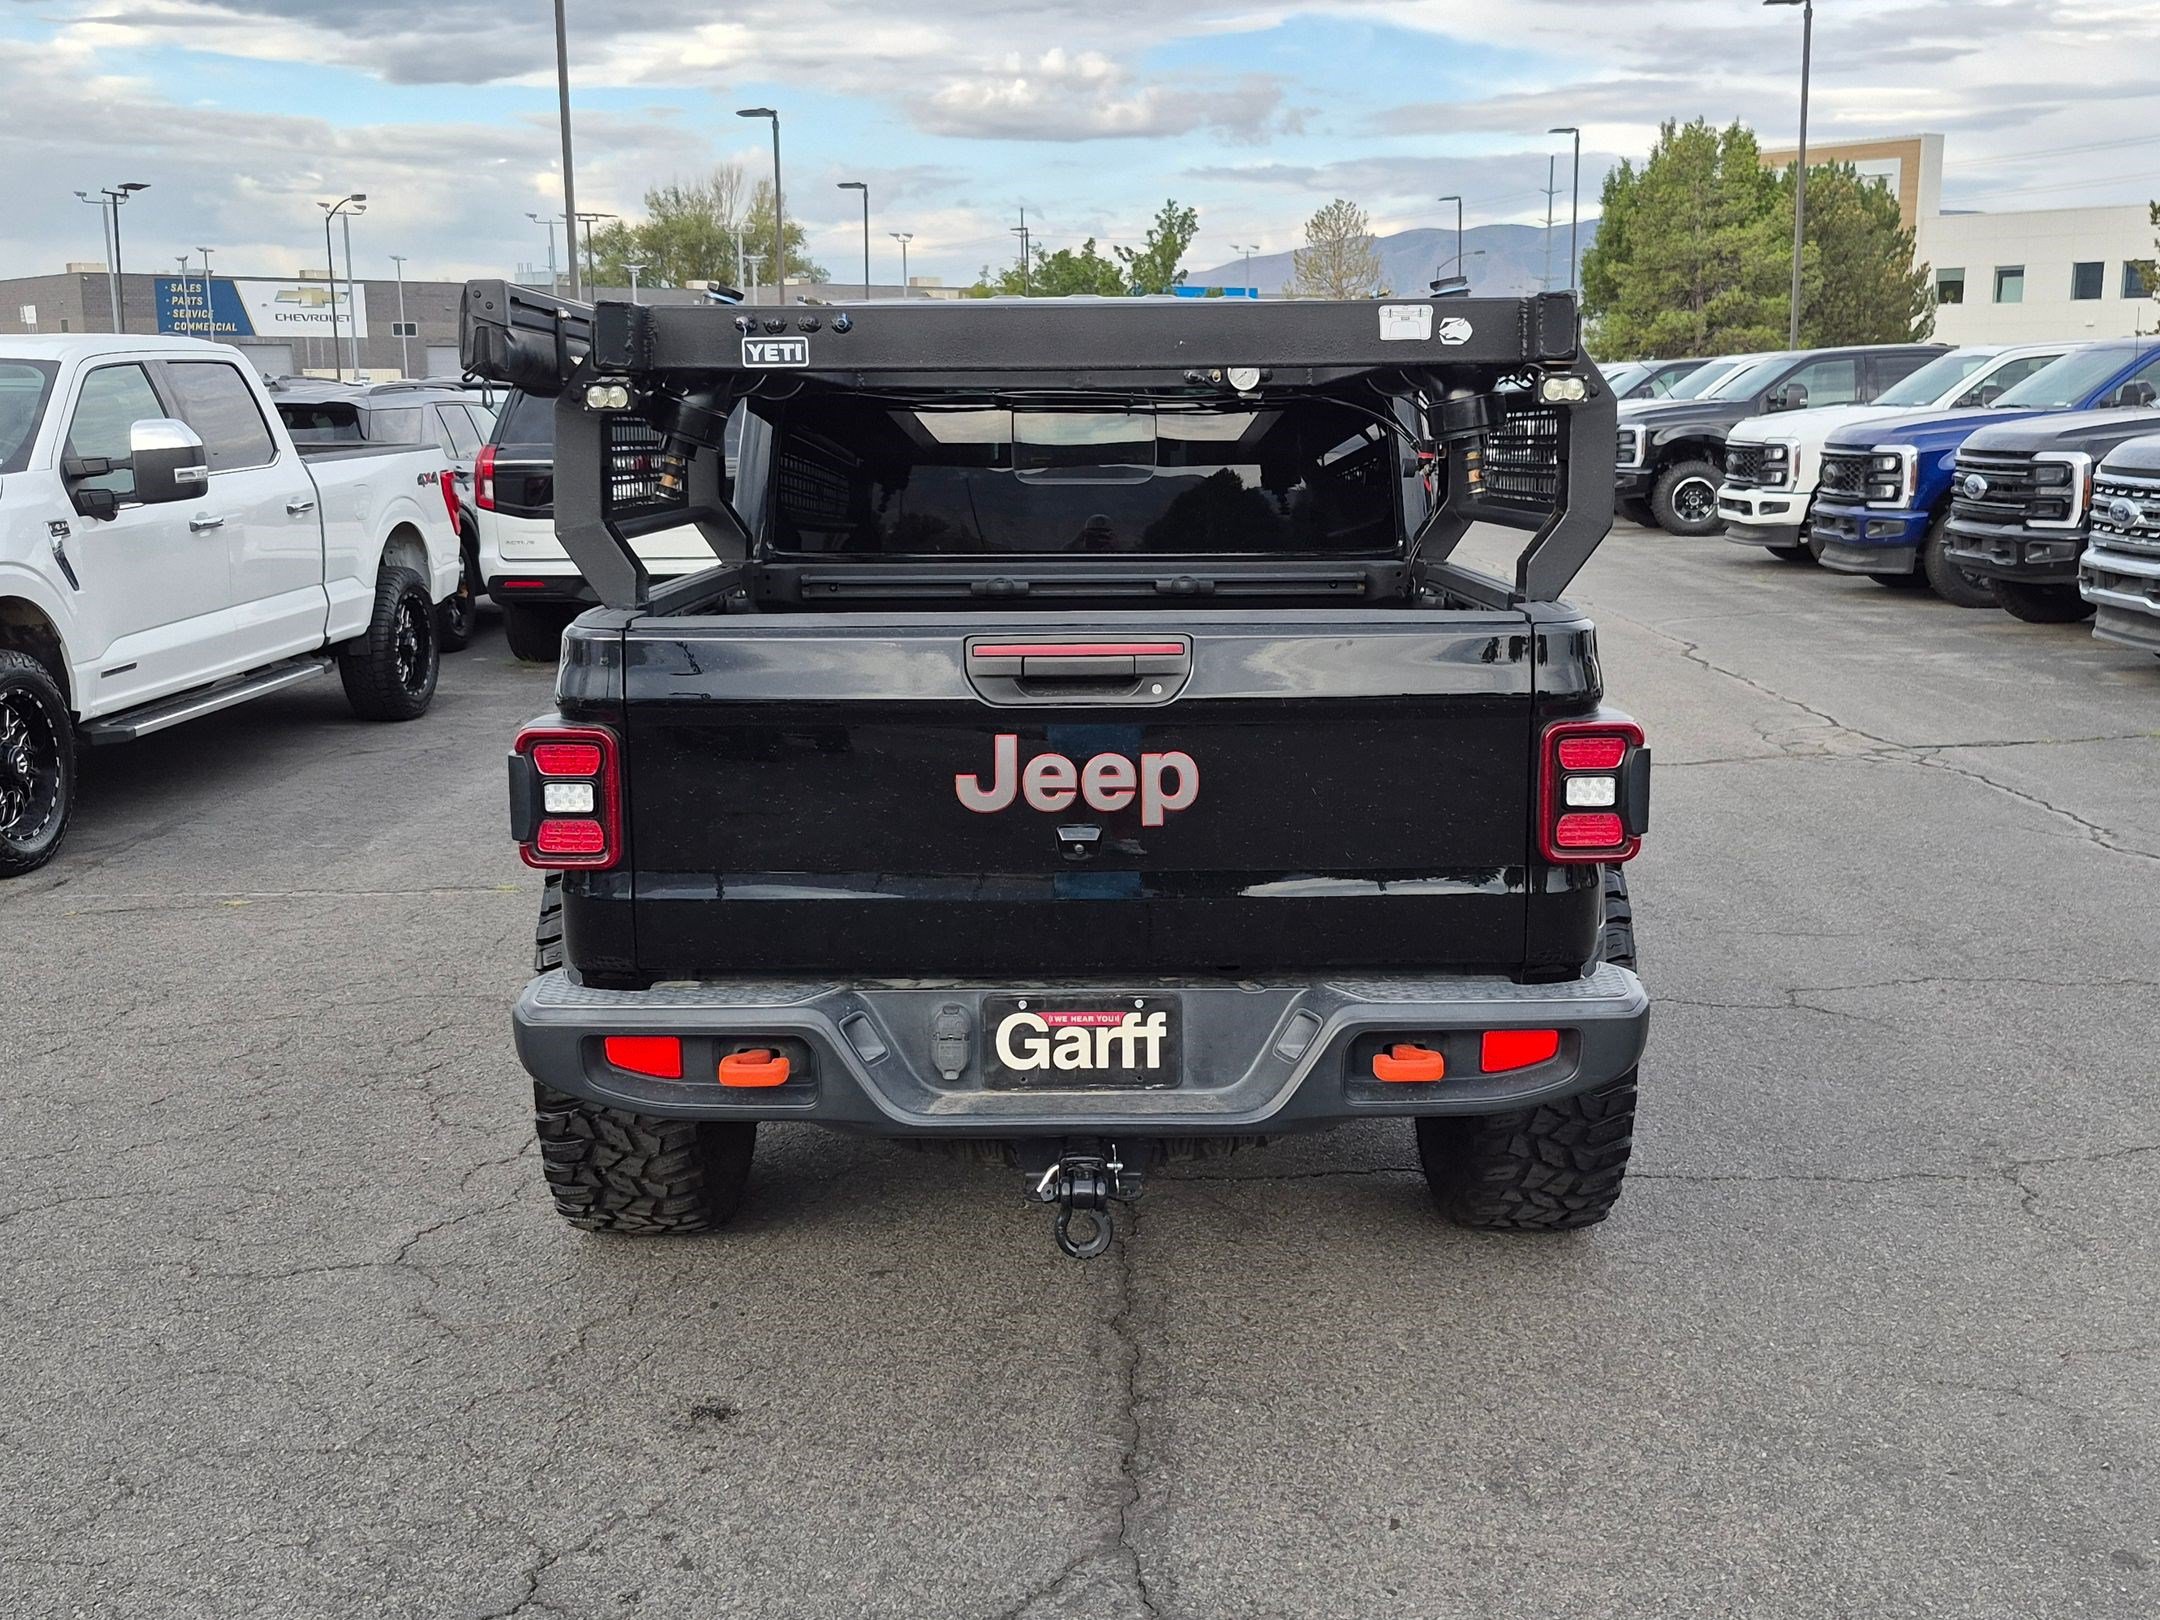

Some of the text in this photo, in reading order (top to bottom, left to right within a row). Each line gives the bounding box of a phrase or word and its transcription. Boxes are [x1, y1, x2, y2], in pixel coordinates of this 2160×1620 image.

[170, 283, 202, 293] SALES
[171, 296, 203, 306] PARTS
[172, 309, 214, 319] SERVICE
[275, 313, 351, 323] CHEVROLET
[174, 322, 238, 332] COMMERCIAL
[746, 343, 803, 361] YETI
[955, 733, 1200, 827] Jeep
[1053, 1015, 1115, 1023] WE HEAR YOU
[996, 1012, 1167, 1071] Garff
